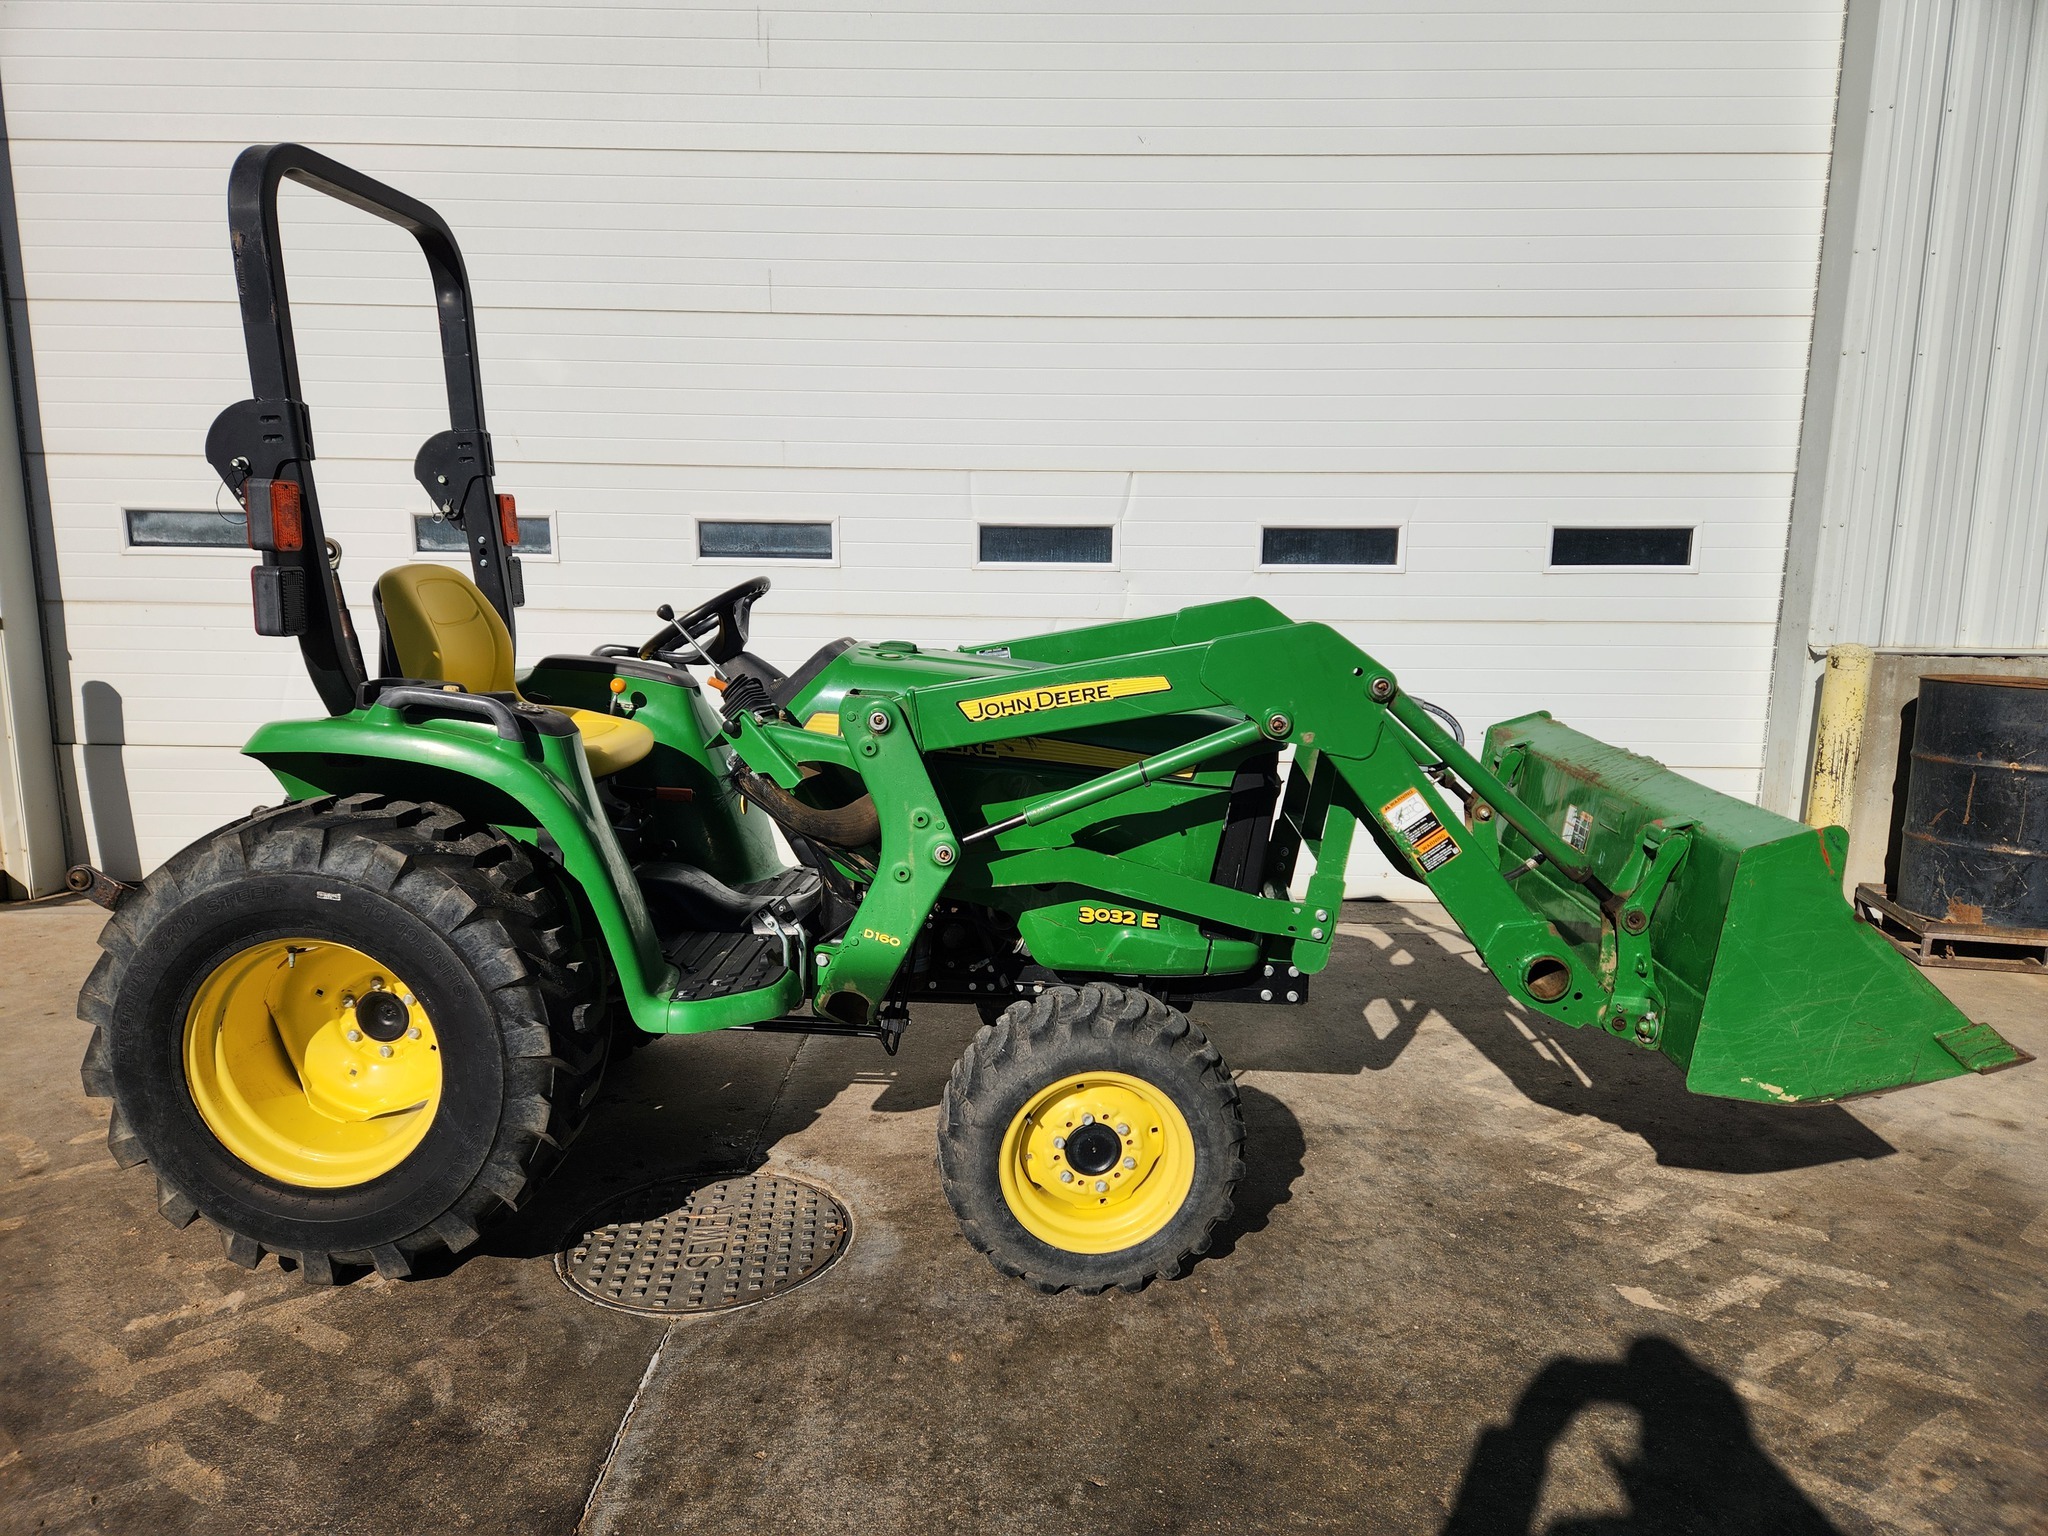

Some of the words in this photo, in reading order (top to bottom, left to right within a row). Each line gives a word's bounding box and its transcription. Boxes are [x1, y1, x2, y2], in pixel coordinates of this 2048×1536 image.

[973, 696, 1032, 719] JOHN
[1036, 684, 1111, 708] DEERE
[1421, 833, 1447, 851] WARNING
[152, 912, 199, 954] SKID
[205, 883, 287, 915] STEER
[1078, 905, 1137, 926] 3032
[1141, 911, 1161, 931] E
[863, 928, 901, 946] D160
[683, 1204, 735, 1270] SEWER
